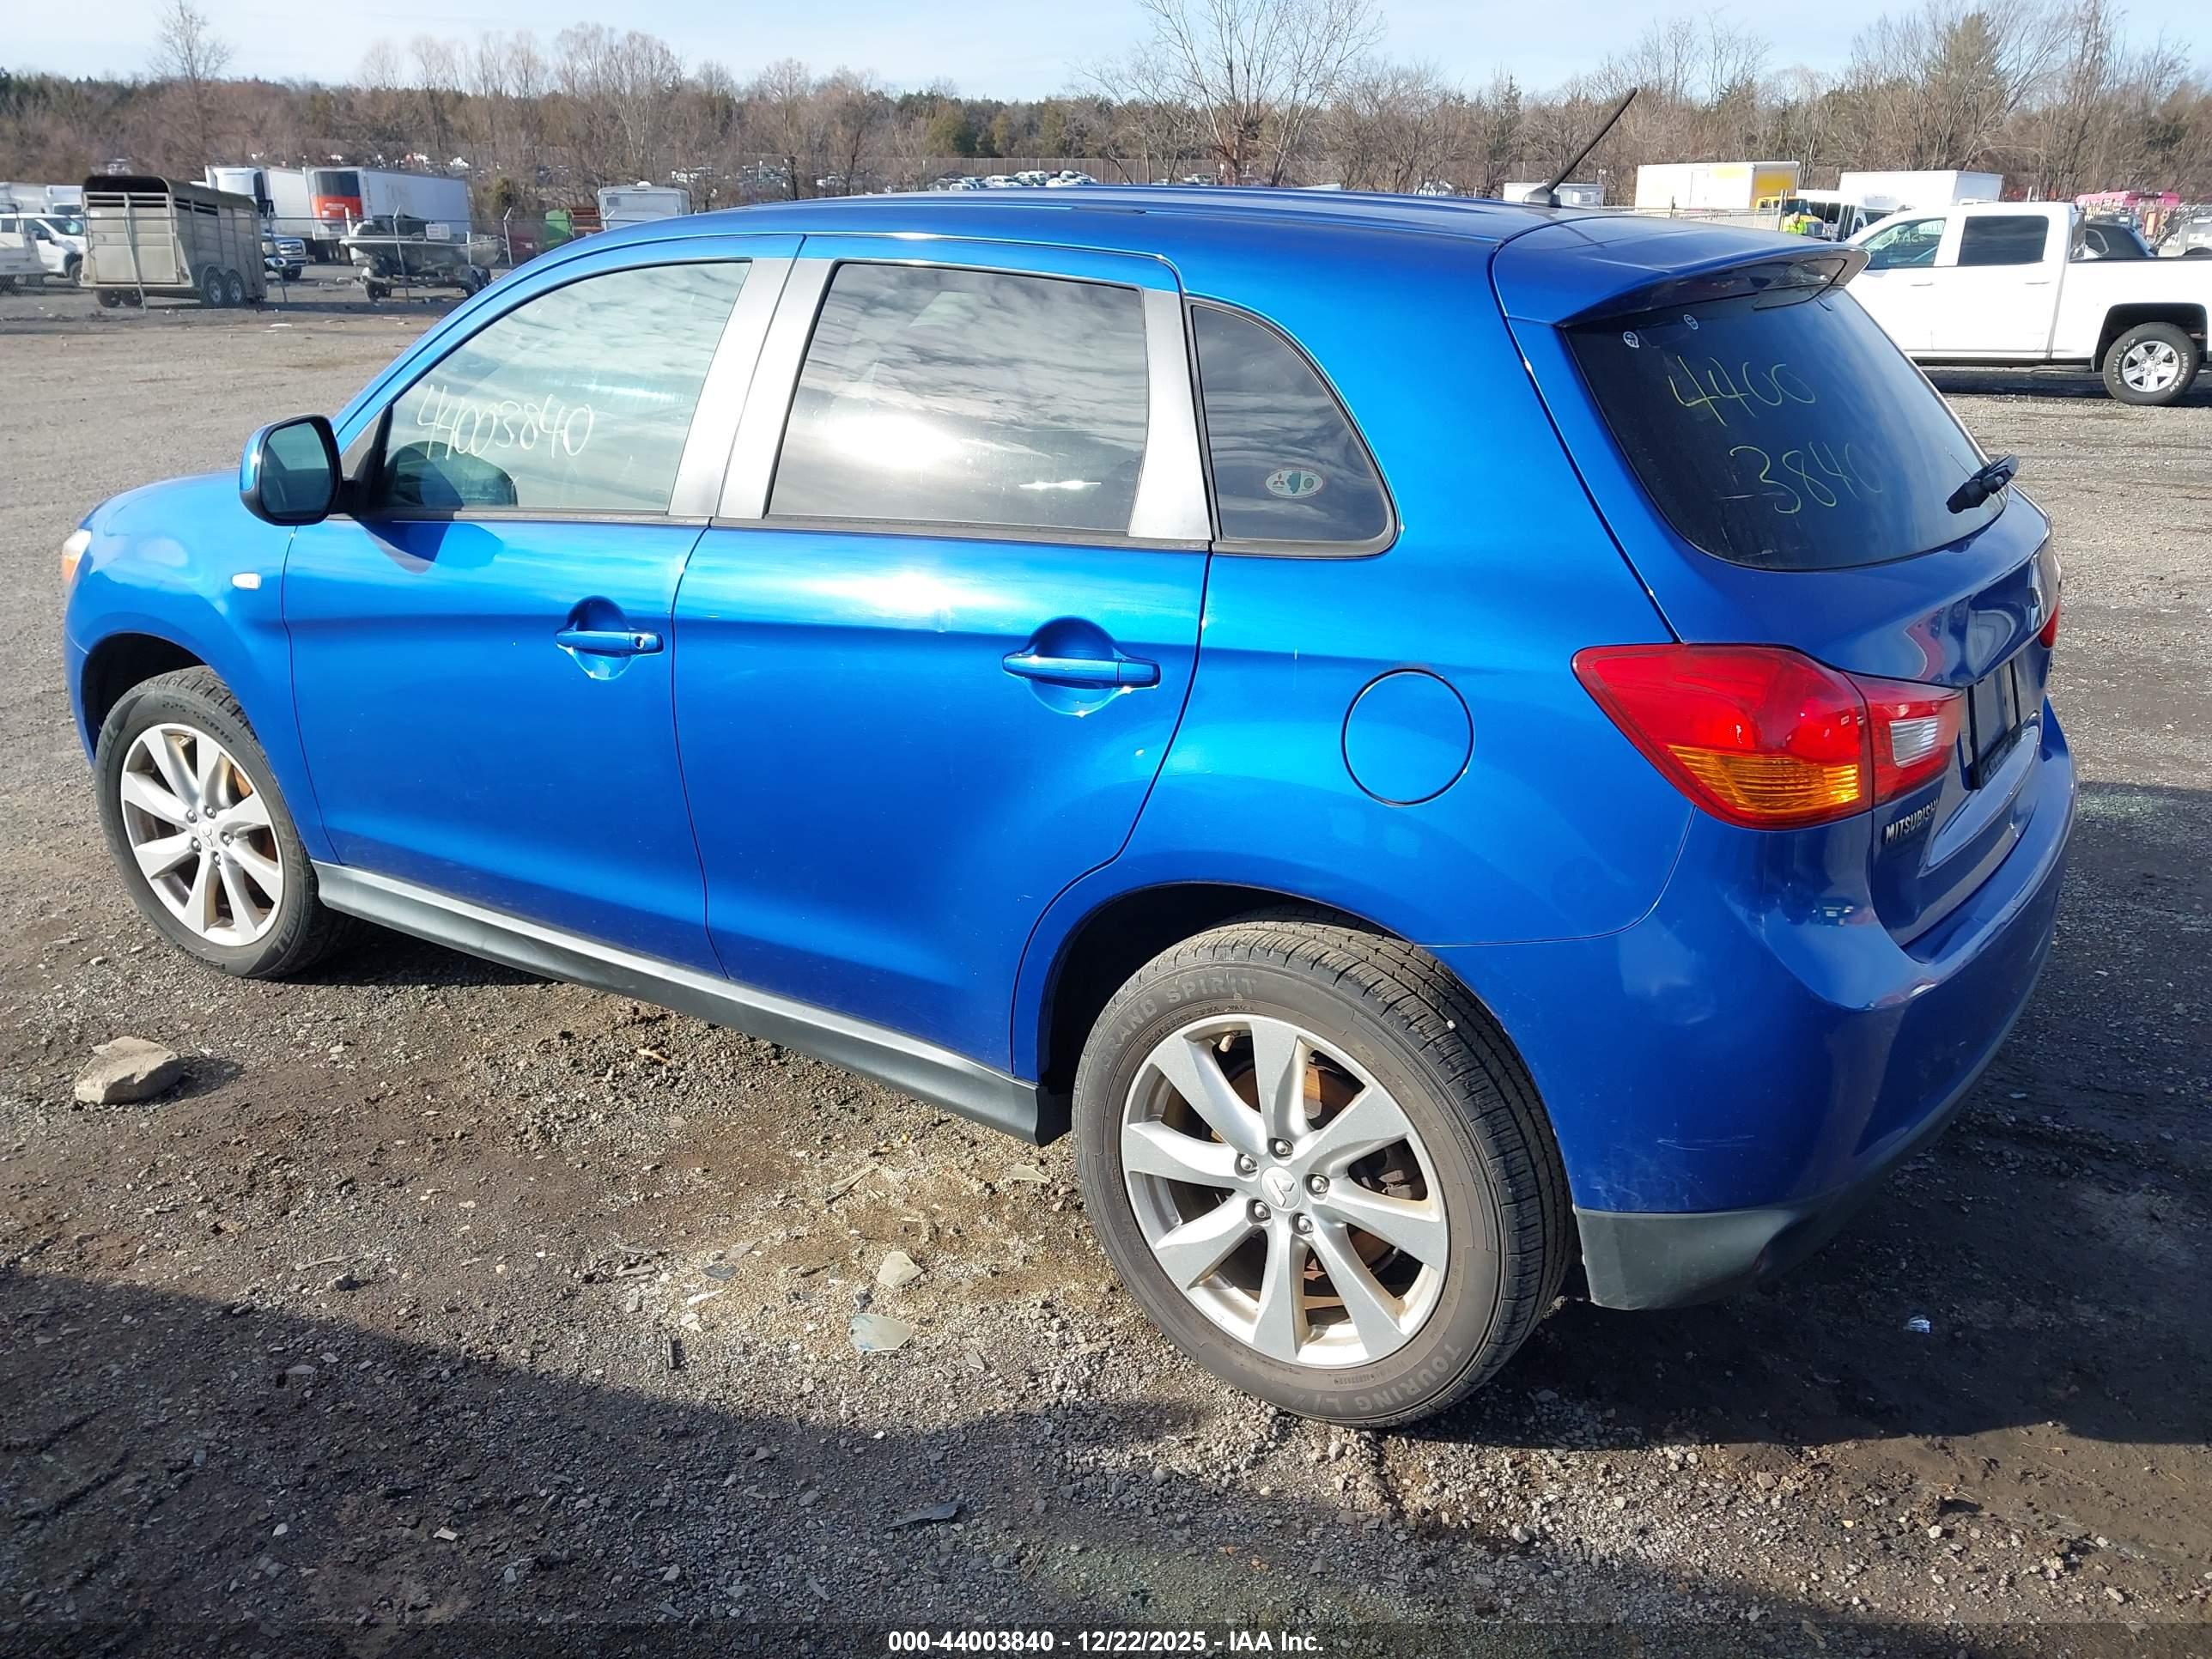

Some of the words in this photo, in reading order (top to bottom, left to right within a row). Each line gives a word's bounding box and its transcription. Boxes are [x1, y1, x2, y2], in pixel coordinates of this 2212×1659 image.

[416, 384, 596, 461] 44003840
[1668, 355, 1817, 427] 4400
[1166, 975, 1258, 1004] SPIRIT
[1354, 1343, 1463, 1412] TOURING
